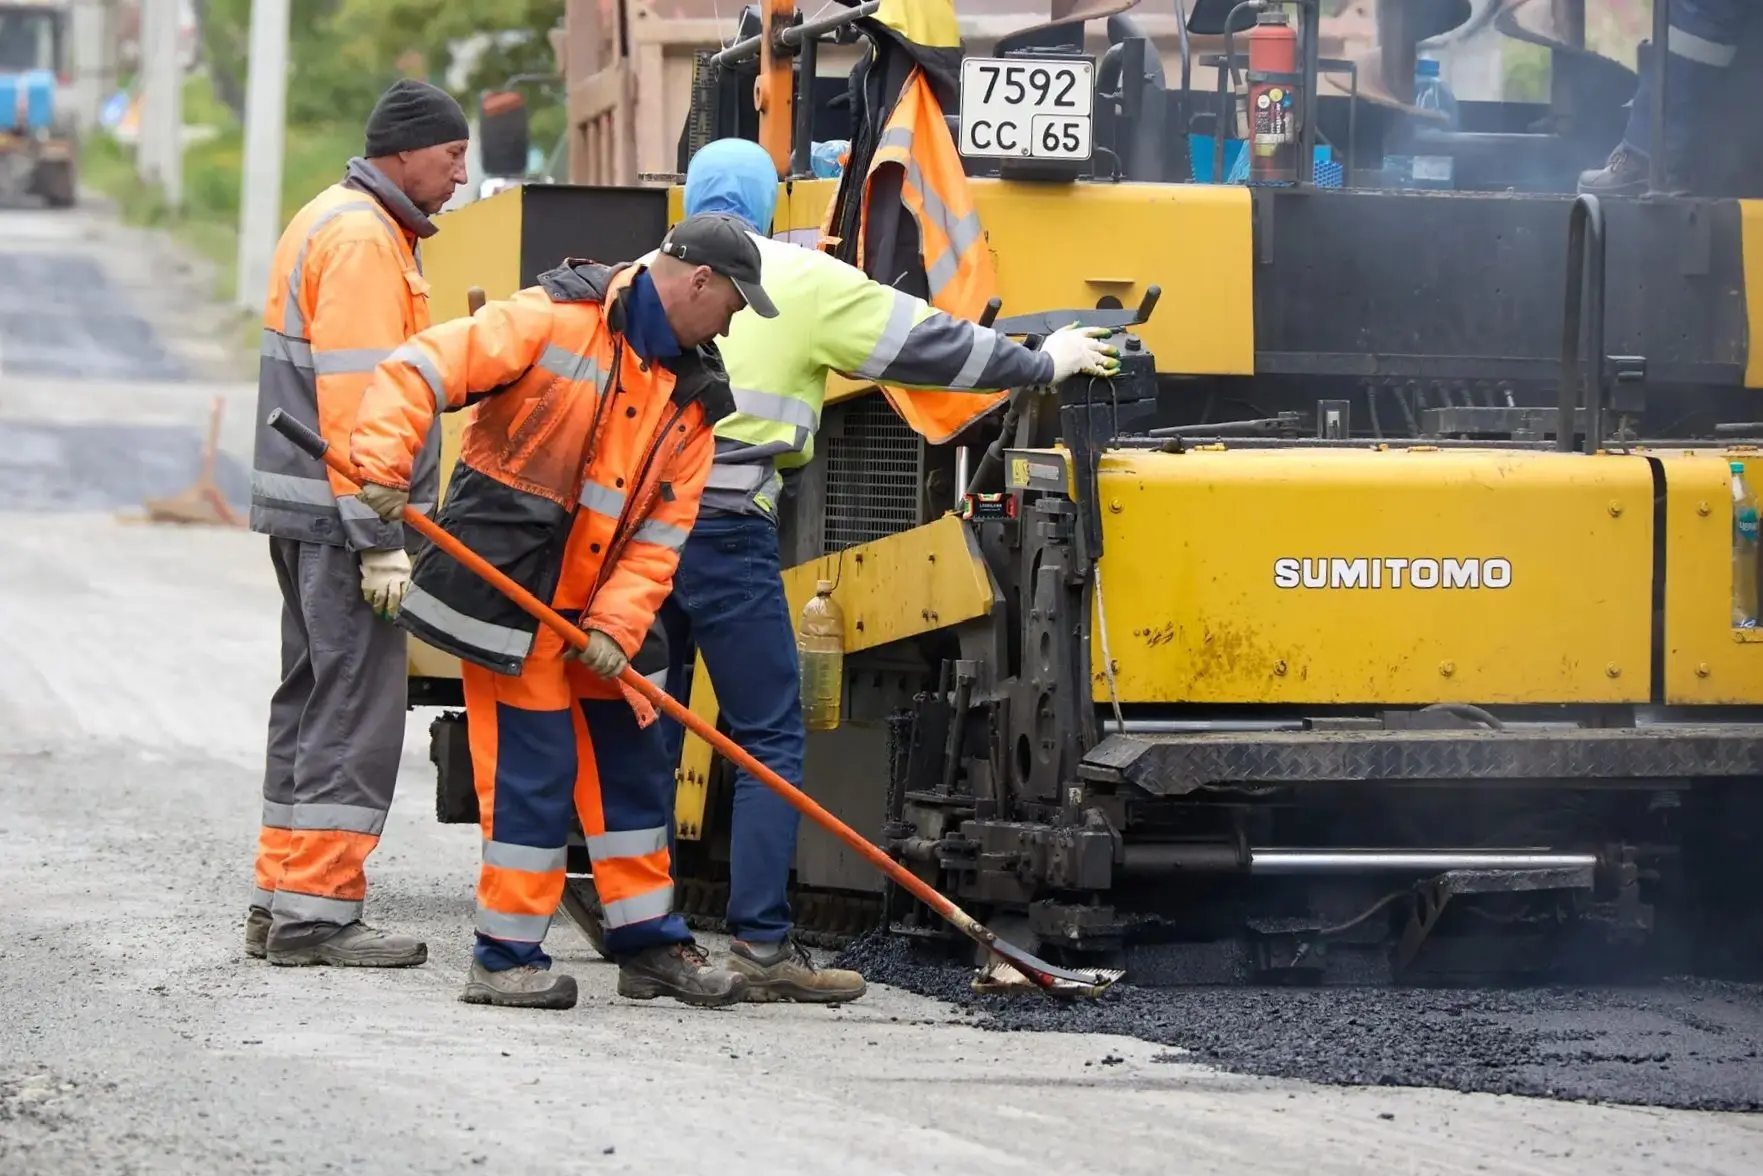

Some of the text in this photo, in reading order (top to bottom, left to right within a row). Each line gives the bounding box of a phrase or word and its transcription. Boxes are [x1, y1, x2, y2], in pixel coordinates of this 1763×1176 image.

[979, 66, 1076, 107] 7592
[1042, 122, 1080, 152] 65
[1273, 557, 1513, 589] SUMITOMO
